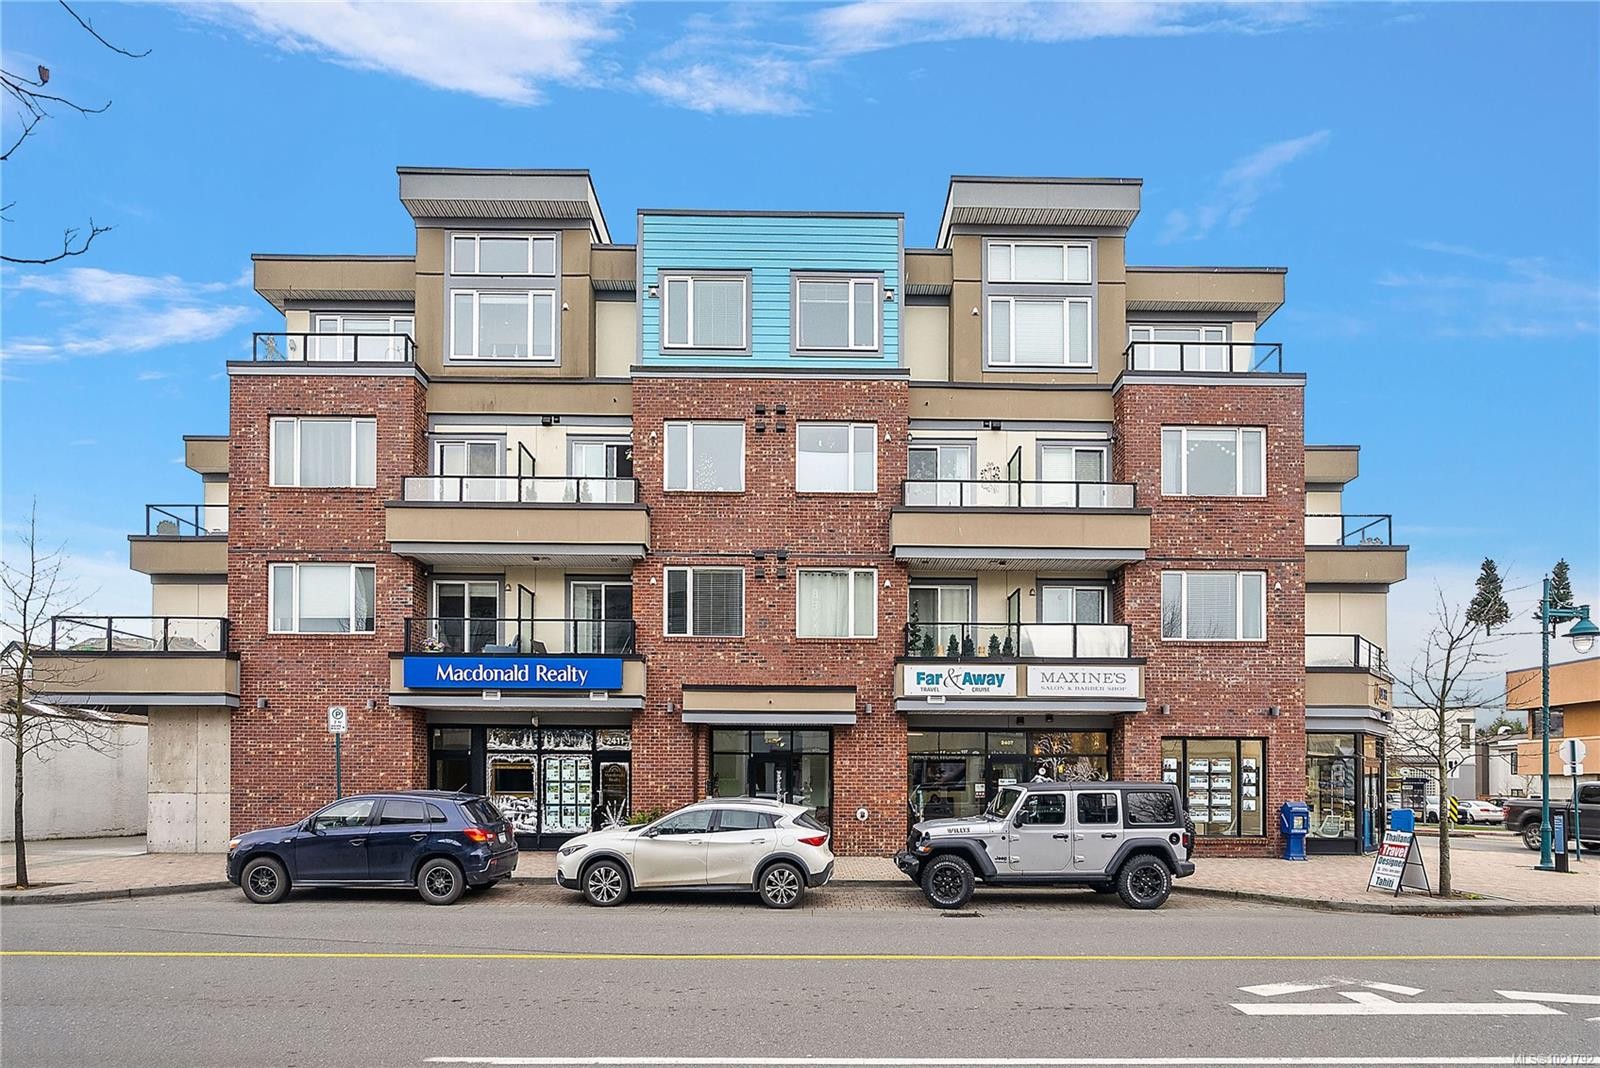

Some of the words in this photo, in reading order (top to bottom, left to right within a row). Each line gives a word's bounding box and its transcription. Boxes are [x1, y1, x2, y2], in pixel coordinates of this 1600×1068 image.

[435, 664, 529, 682] Macdonald
[536, 664, 588, 685] Realty
[916, 671, 943, 686] Far
[962, 671, 1006, 688] Away
[1040, 671, 1127, 684] MAXINE'S
[606, 737, 624, 745] 2411
[1385, 832, 1413, 844] Thailand
[1382, 844, 1409, 858] Travel
[1378, 856, 1406, 868] Designer
[1375, 876, 1395, 888] Tahiti
